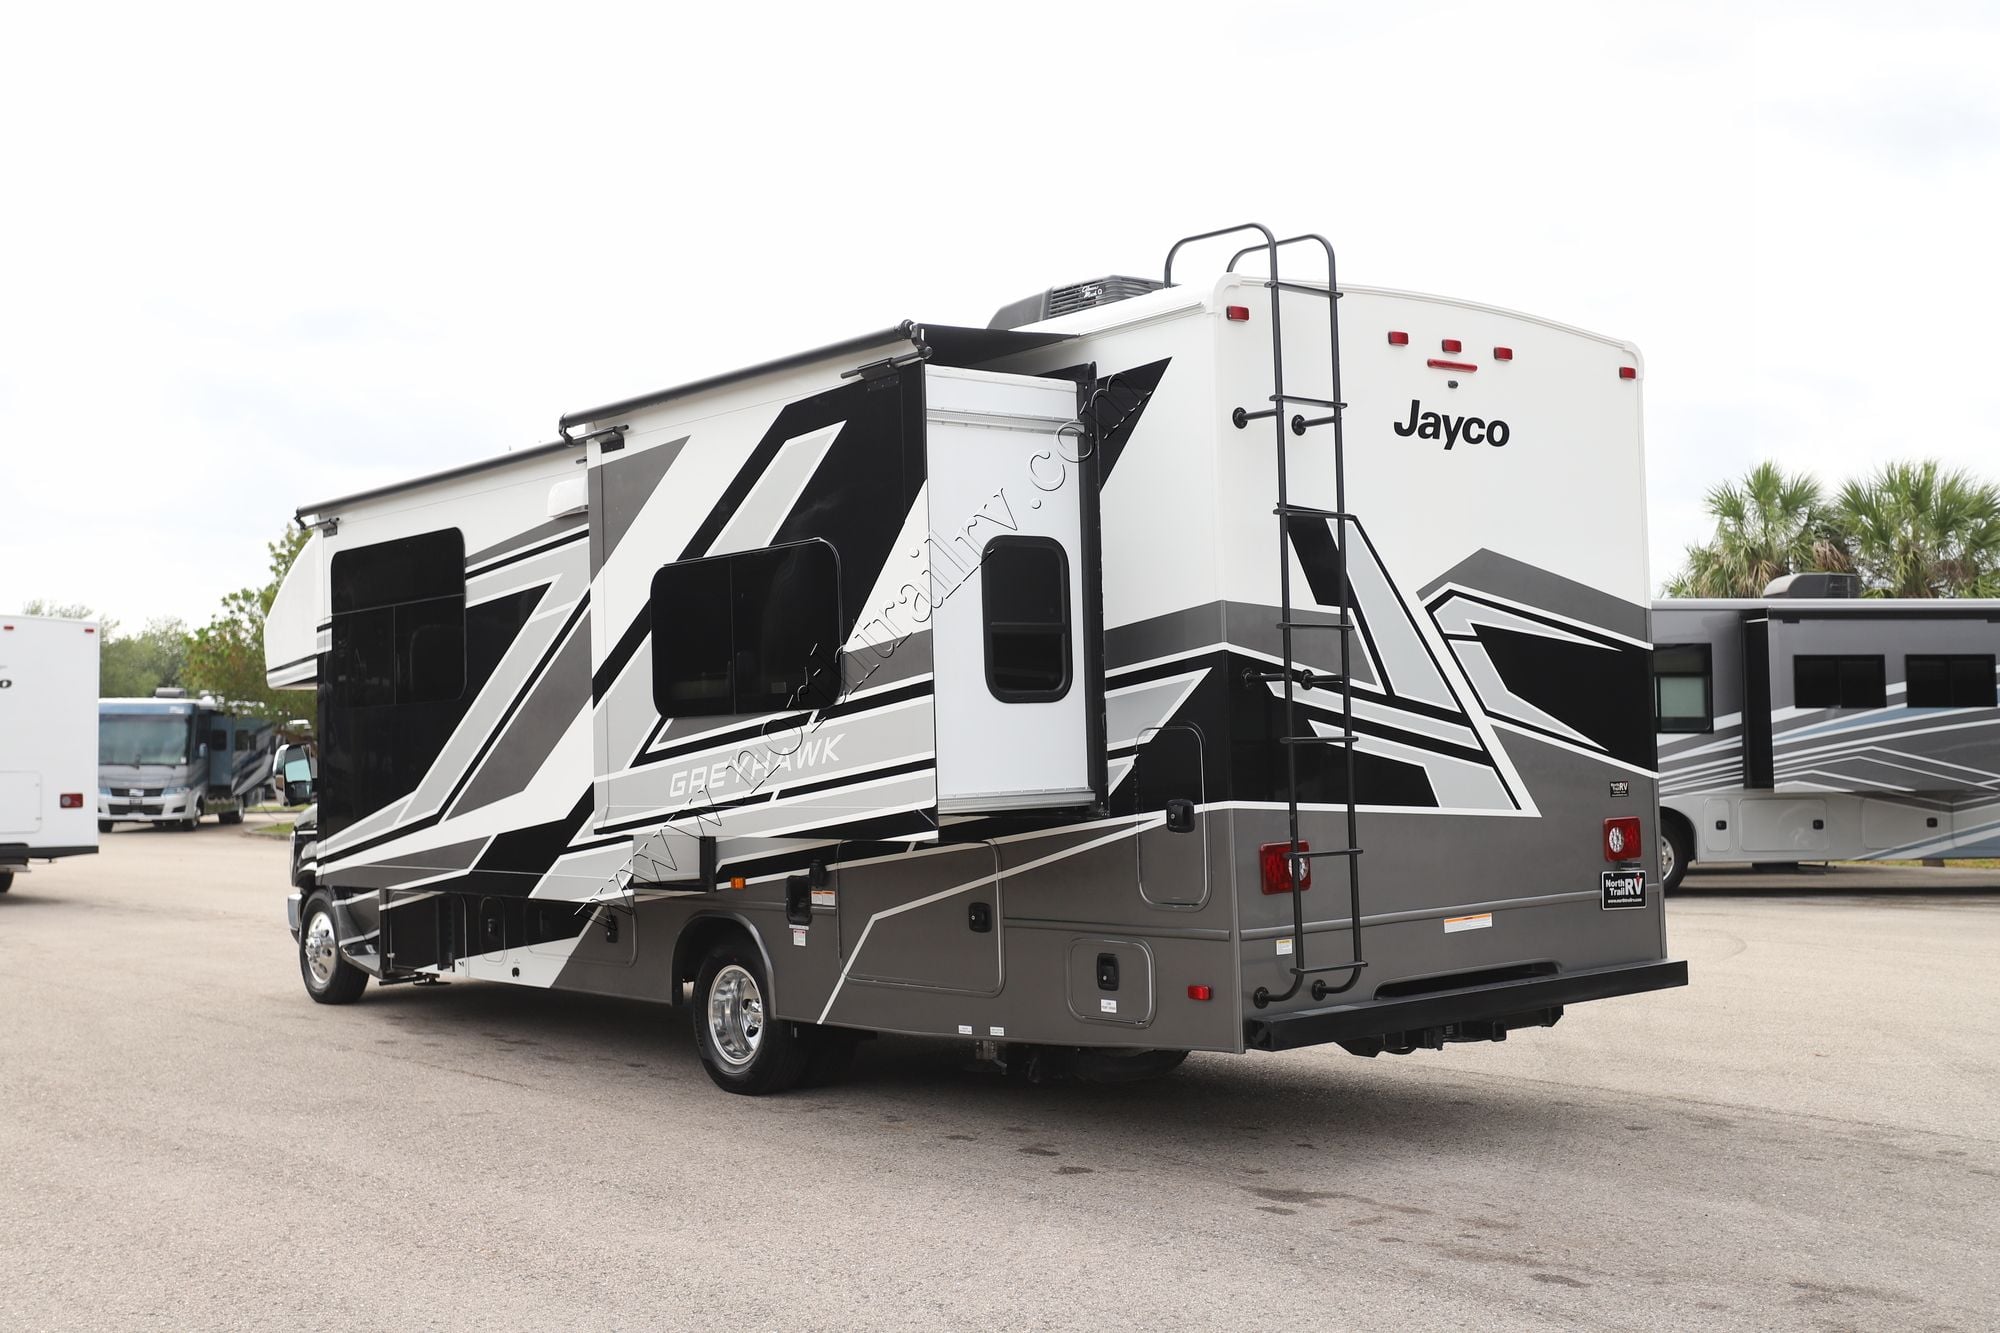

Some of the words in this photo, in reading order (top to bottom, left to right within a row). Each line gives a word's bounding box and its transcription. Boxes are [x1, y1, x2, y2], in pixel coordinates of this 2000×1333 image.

[1393, 399, 1510, 450] Jayco
[669, 733, 847, 798] GREYHAWK
[1605, 879, 1625, 888] North
[1609, 887, 1625, 896] Trail
[1625, 878, 1643, 896] RV
